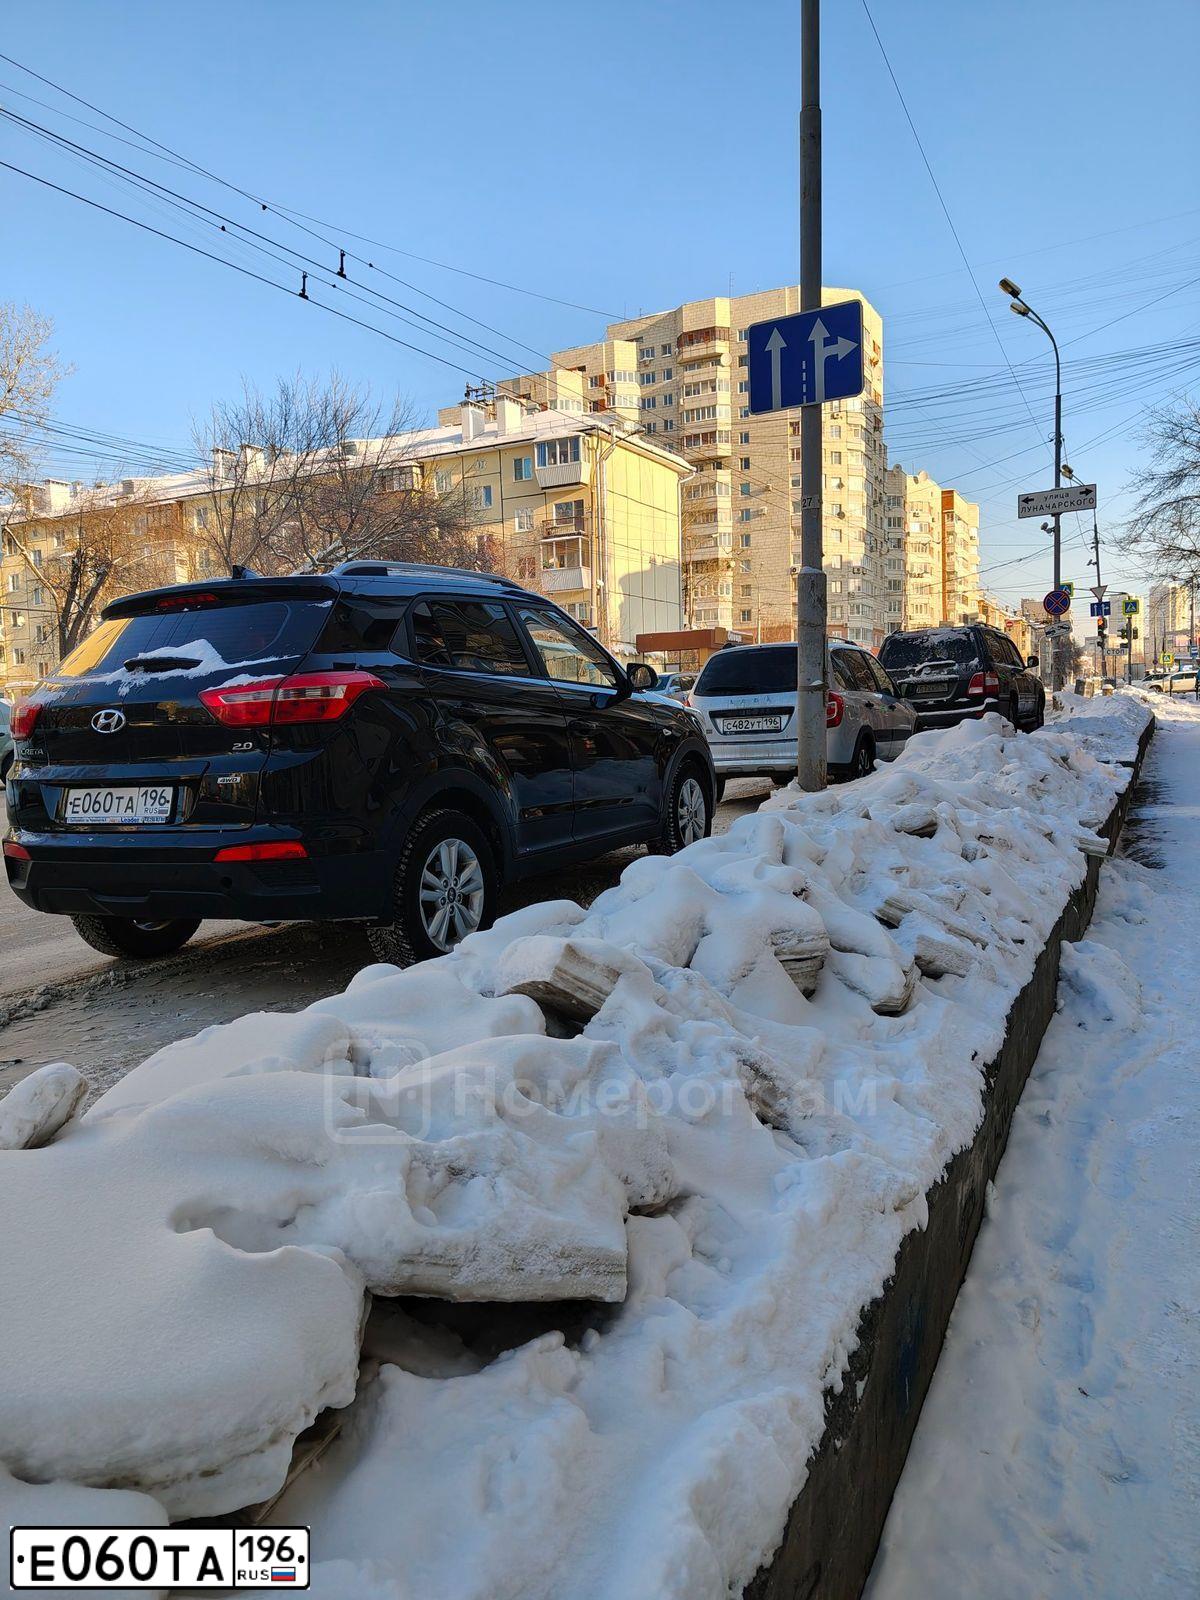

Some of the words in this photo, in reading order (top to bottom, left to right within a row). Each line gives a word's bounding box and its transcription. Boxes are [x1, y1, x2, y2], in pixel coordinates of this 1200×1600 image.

[1043, 492, 1069, 501] улица
[1020, 497, 1095, 514] ЛУНАЧАРСКОГО
[764, 717, 778, 726] 196
[71, 791, 135, 814] Е060ТА
[141, 789, 167, 807] 196
